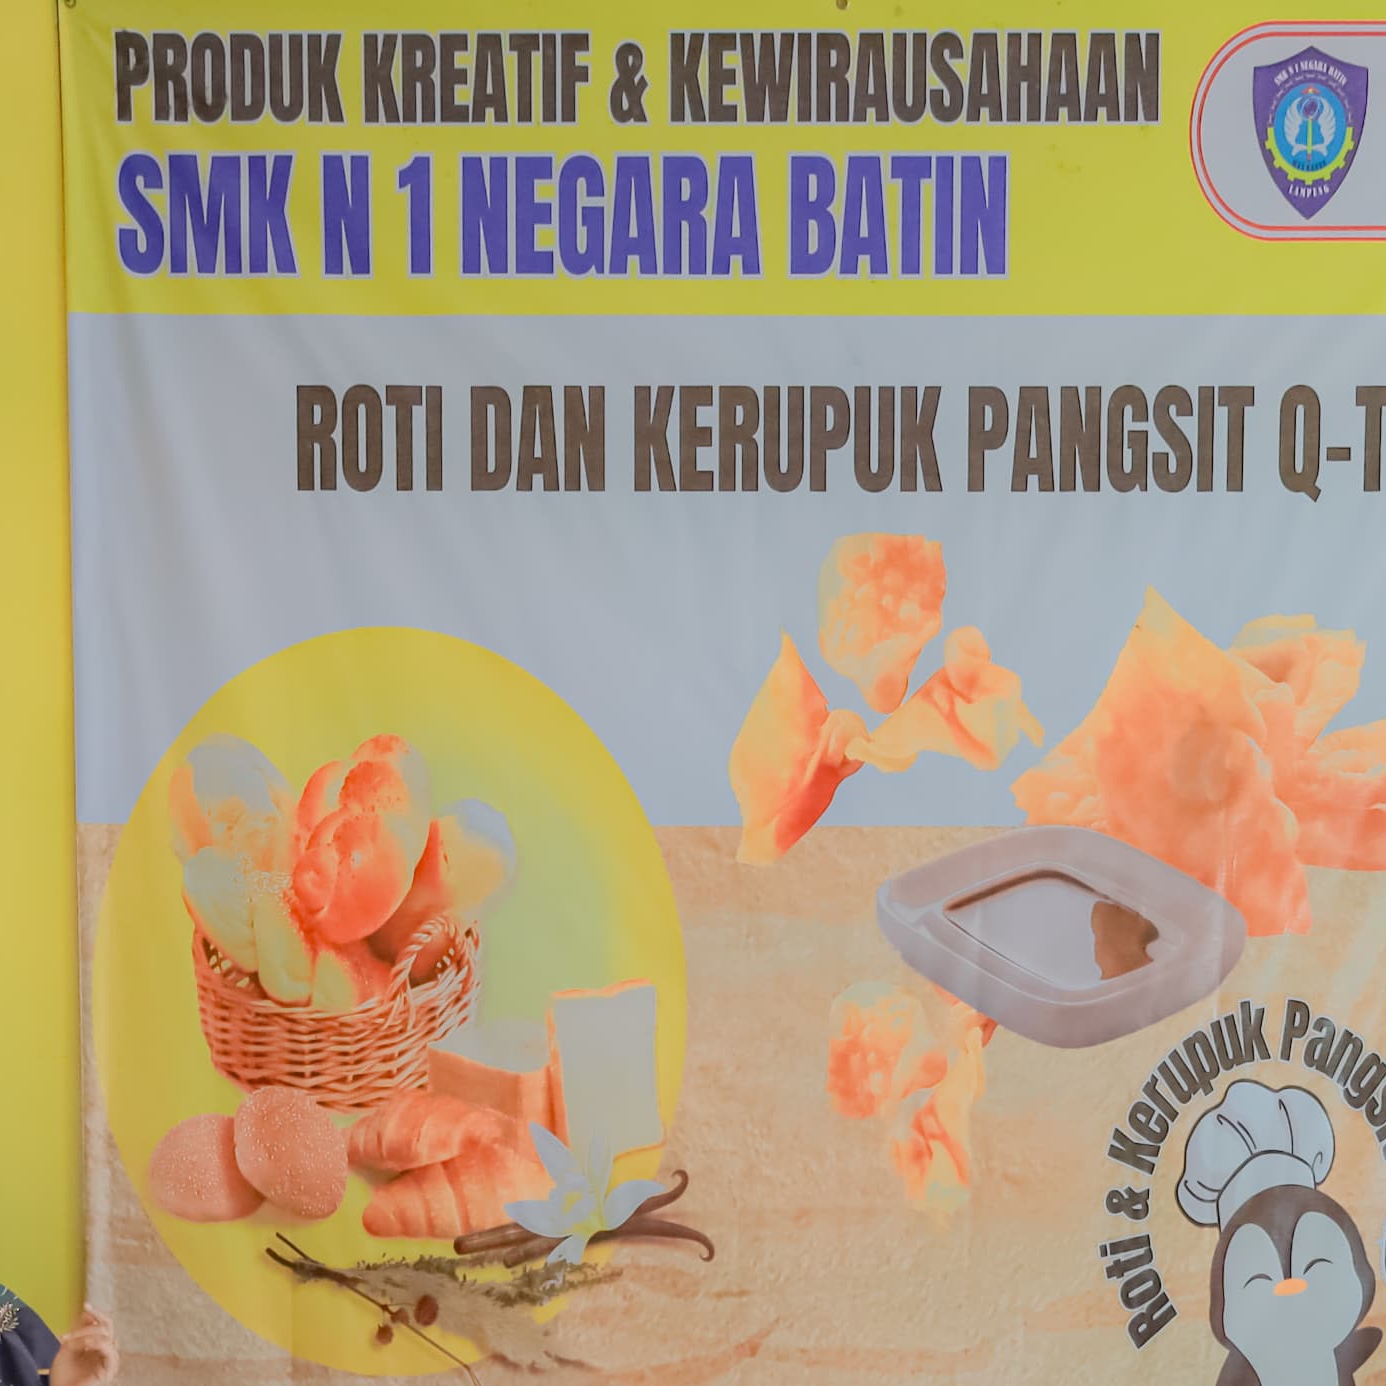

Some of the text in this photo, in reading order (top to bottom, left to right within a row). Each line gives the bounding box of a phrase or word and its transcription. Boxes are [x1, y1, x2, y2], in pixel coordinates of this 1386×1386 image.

[114, 31, 1161, 124] PRODUK KREATIF & KEWIRAUSAHAAN
[118, 153, 1008, 276] SMK N 1 NEGARA BATIN
[297, 386, 443, 491] ROTI
[470, 386, 606, 491] DAN
[634, 386, 941, 492] KERUPUK
[968, 386, 1255, 492] PANGSIT
[1107, 999, 1270, 1175] Kerupuk
[1105, 1187, 1151, 1220] &
[1099, 1233, 1177, 1349] Roti
